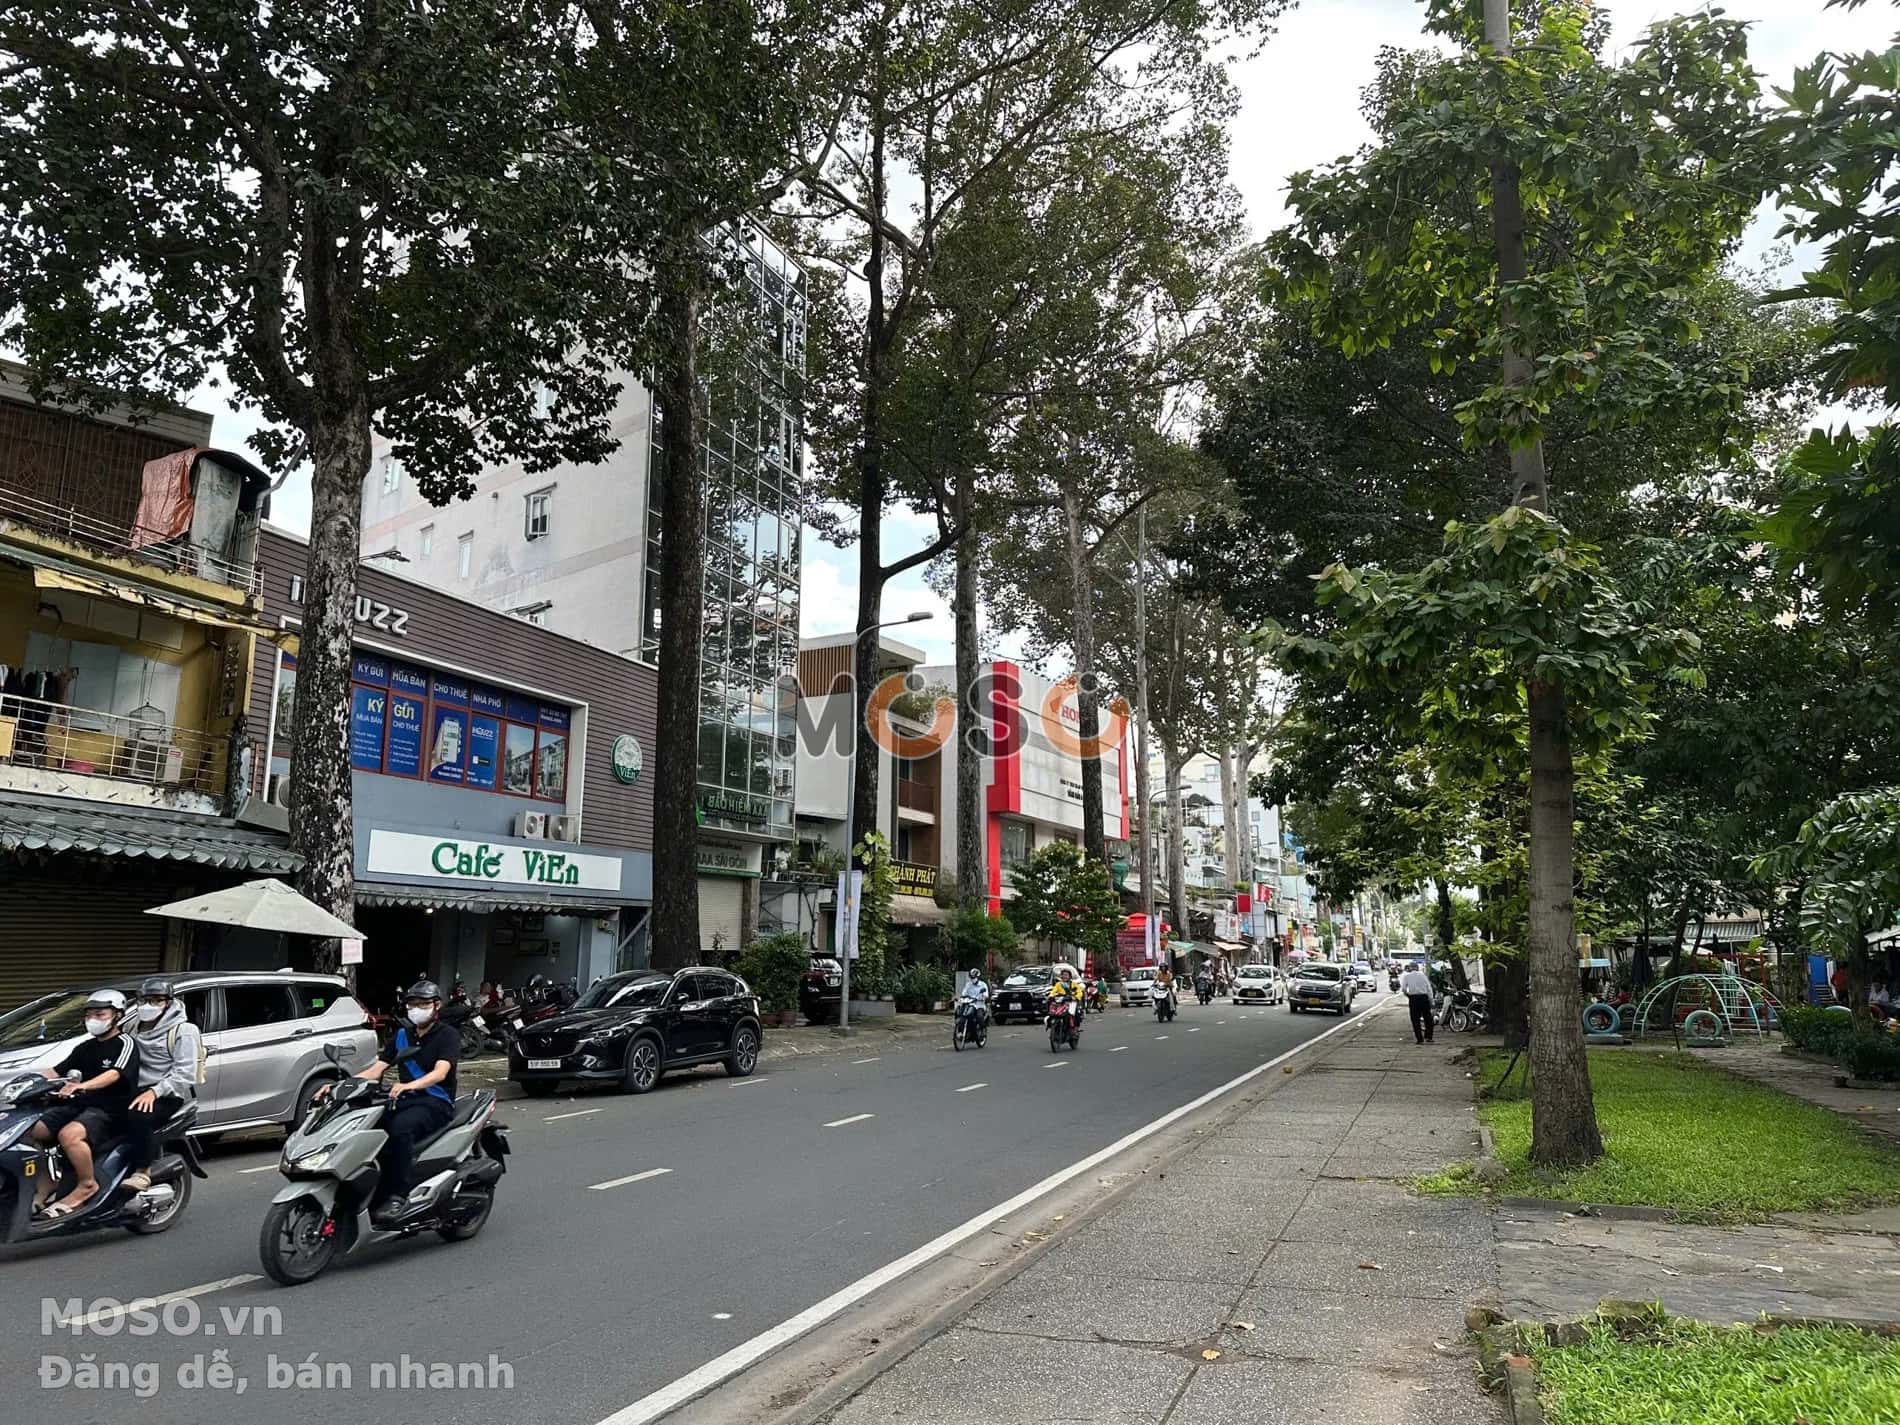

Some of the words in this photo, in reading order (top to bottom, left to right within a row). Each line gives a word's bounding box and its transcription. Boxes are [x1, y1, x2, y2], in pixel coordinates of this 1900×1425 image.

[433, 682, 449, 694] CHO
[367, 697, 385, 713] KÝ
[431, 842, 504, 879] Café
[522, 850, 579, 885] ViEn
